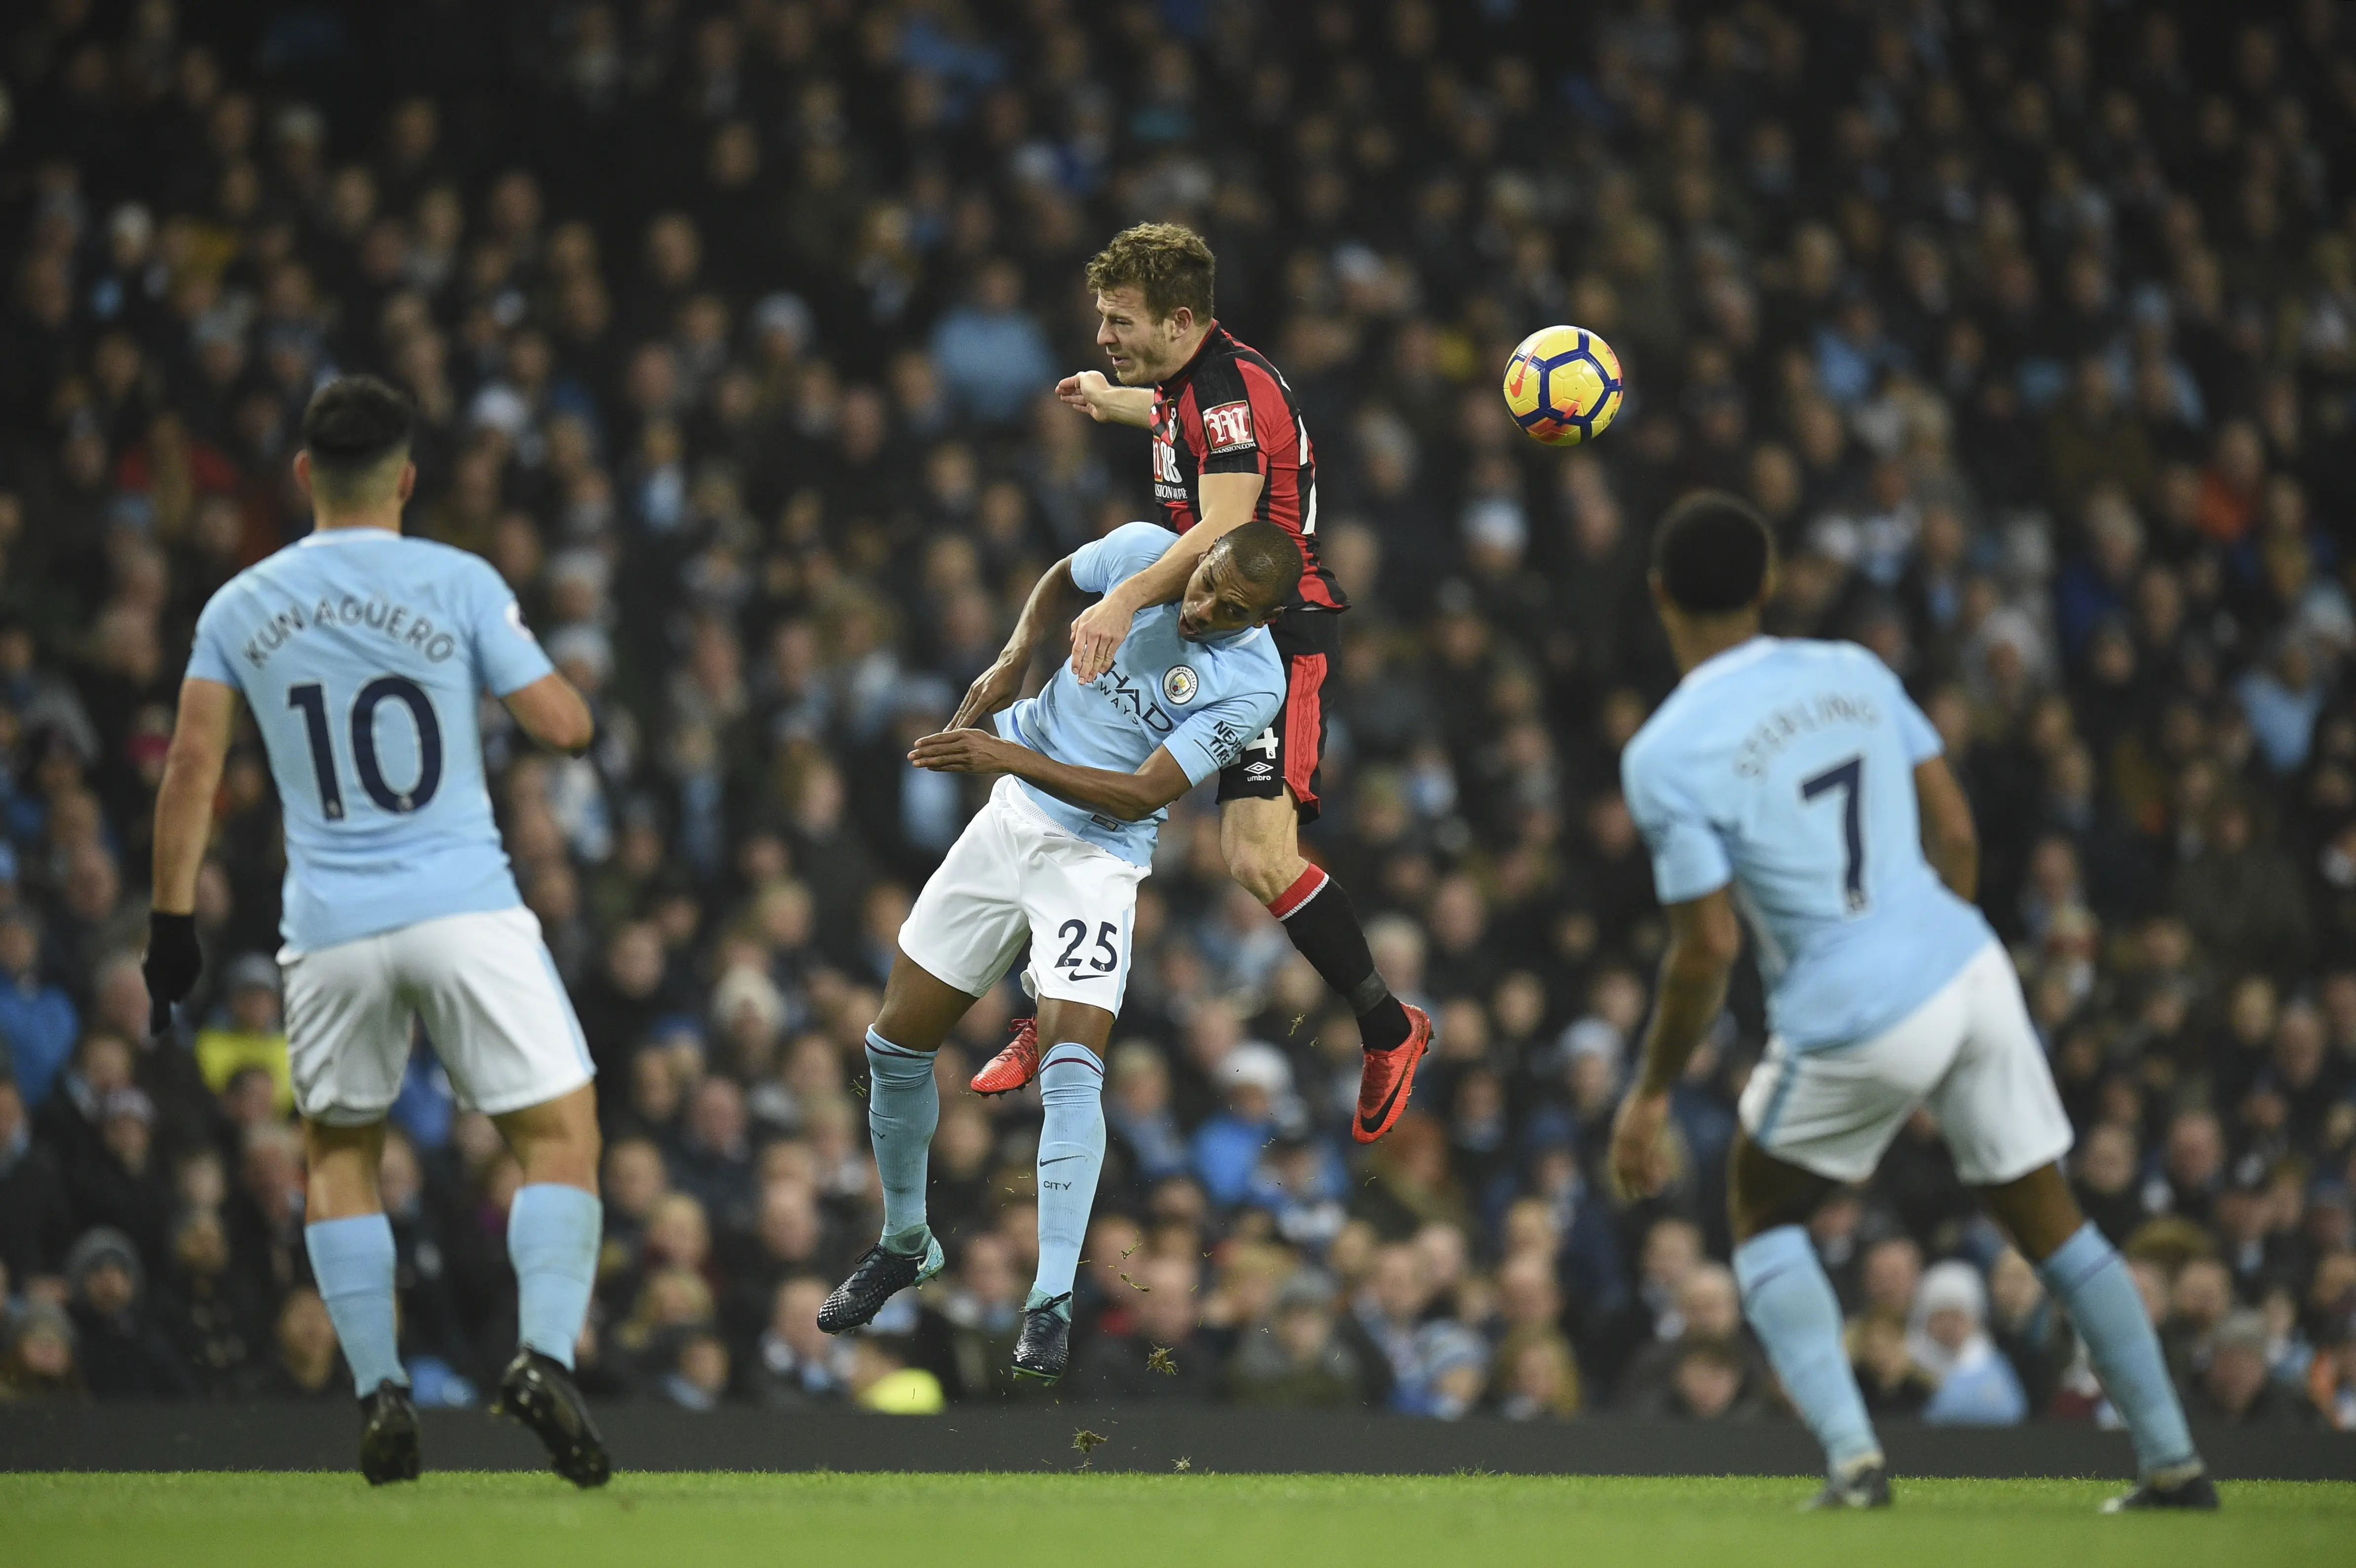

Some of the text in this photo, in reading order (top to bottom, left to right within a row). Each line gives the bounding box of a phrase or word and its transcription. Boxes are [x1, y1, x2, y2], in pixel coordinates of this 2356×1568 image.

[244, 605, 305, 670] KUN
[1099, 680, 1139, 725] WAYS
[1102, 659, 1174, 732] HAD
[1177, 668, 1196, 694] MANCHESTER
[288, 673, 444, 821] 10
[1209, 736, 1230, 765] TIRE
[1800, 750, 1864, 913] 7
[1054, 919, 1117, 972] 25
[1043, 1180, 1072, 1191] CITY
